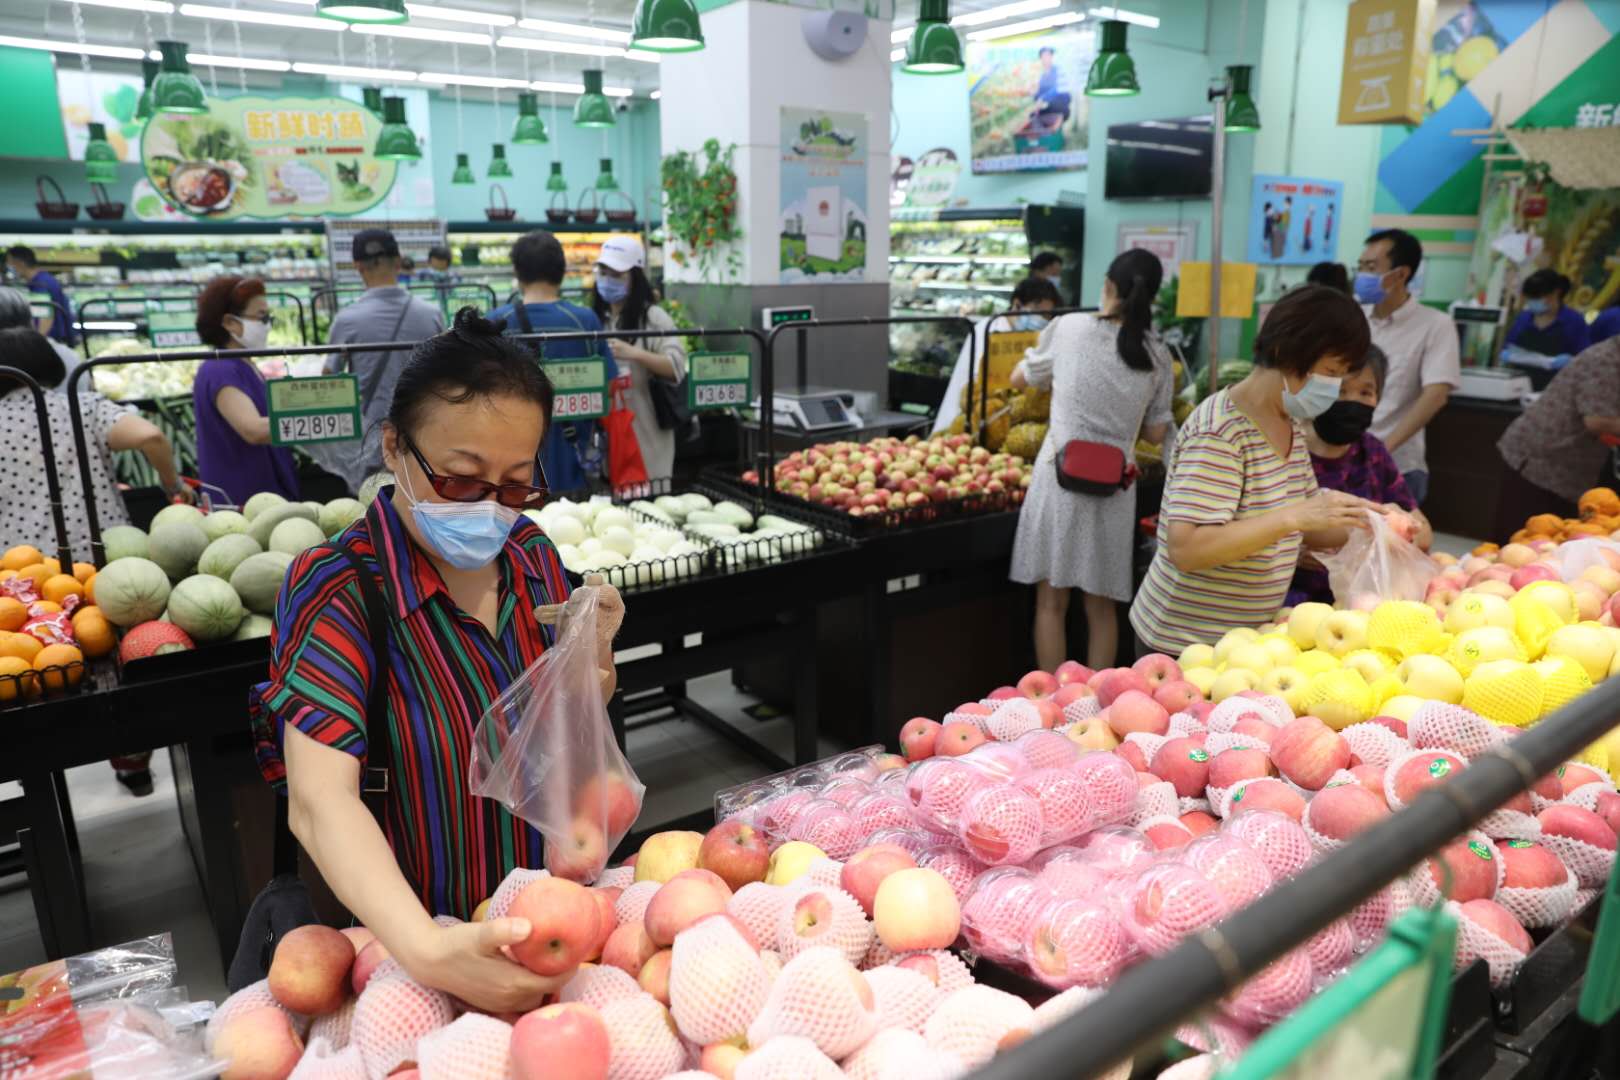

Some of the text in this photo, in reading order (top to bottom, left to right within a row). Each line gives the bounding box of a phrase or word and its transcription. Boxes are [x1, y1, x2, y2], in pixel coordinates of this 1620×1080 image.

[246, 111, 365, 140] 新鲜时蔬
[1575, 102, 1620, 128] 新
